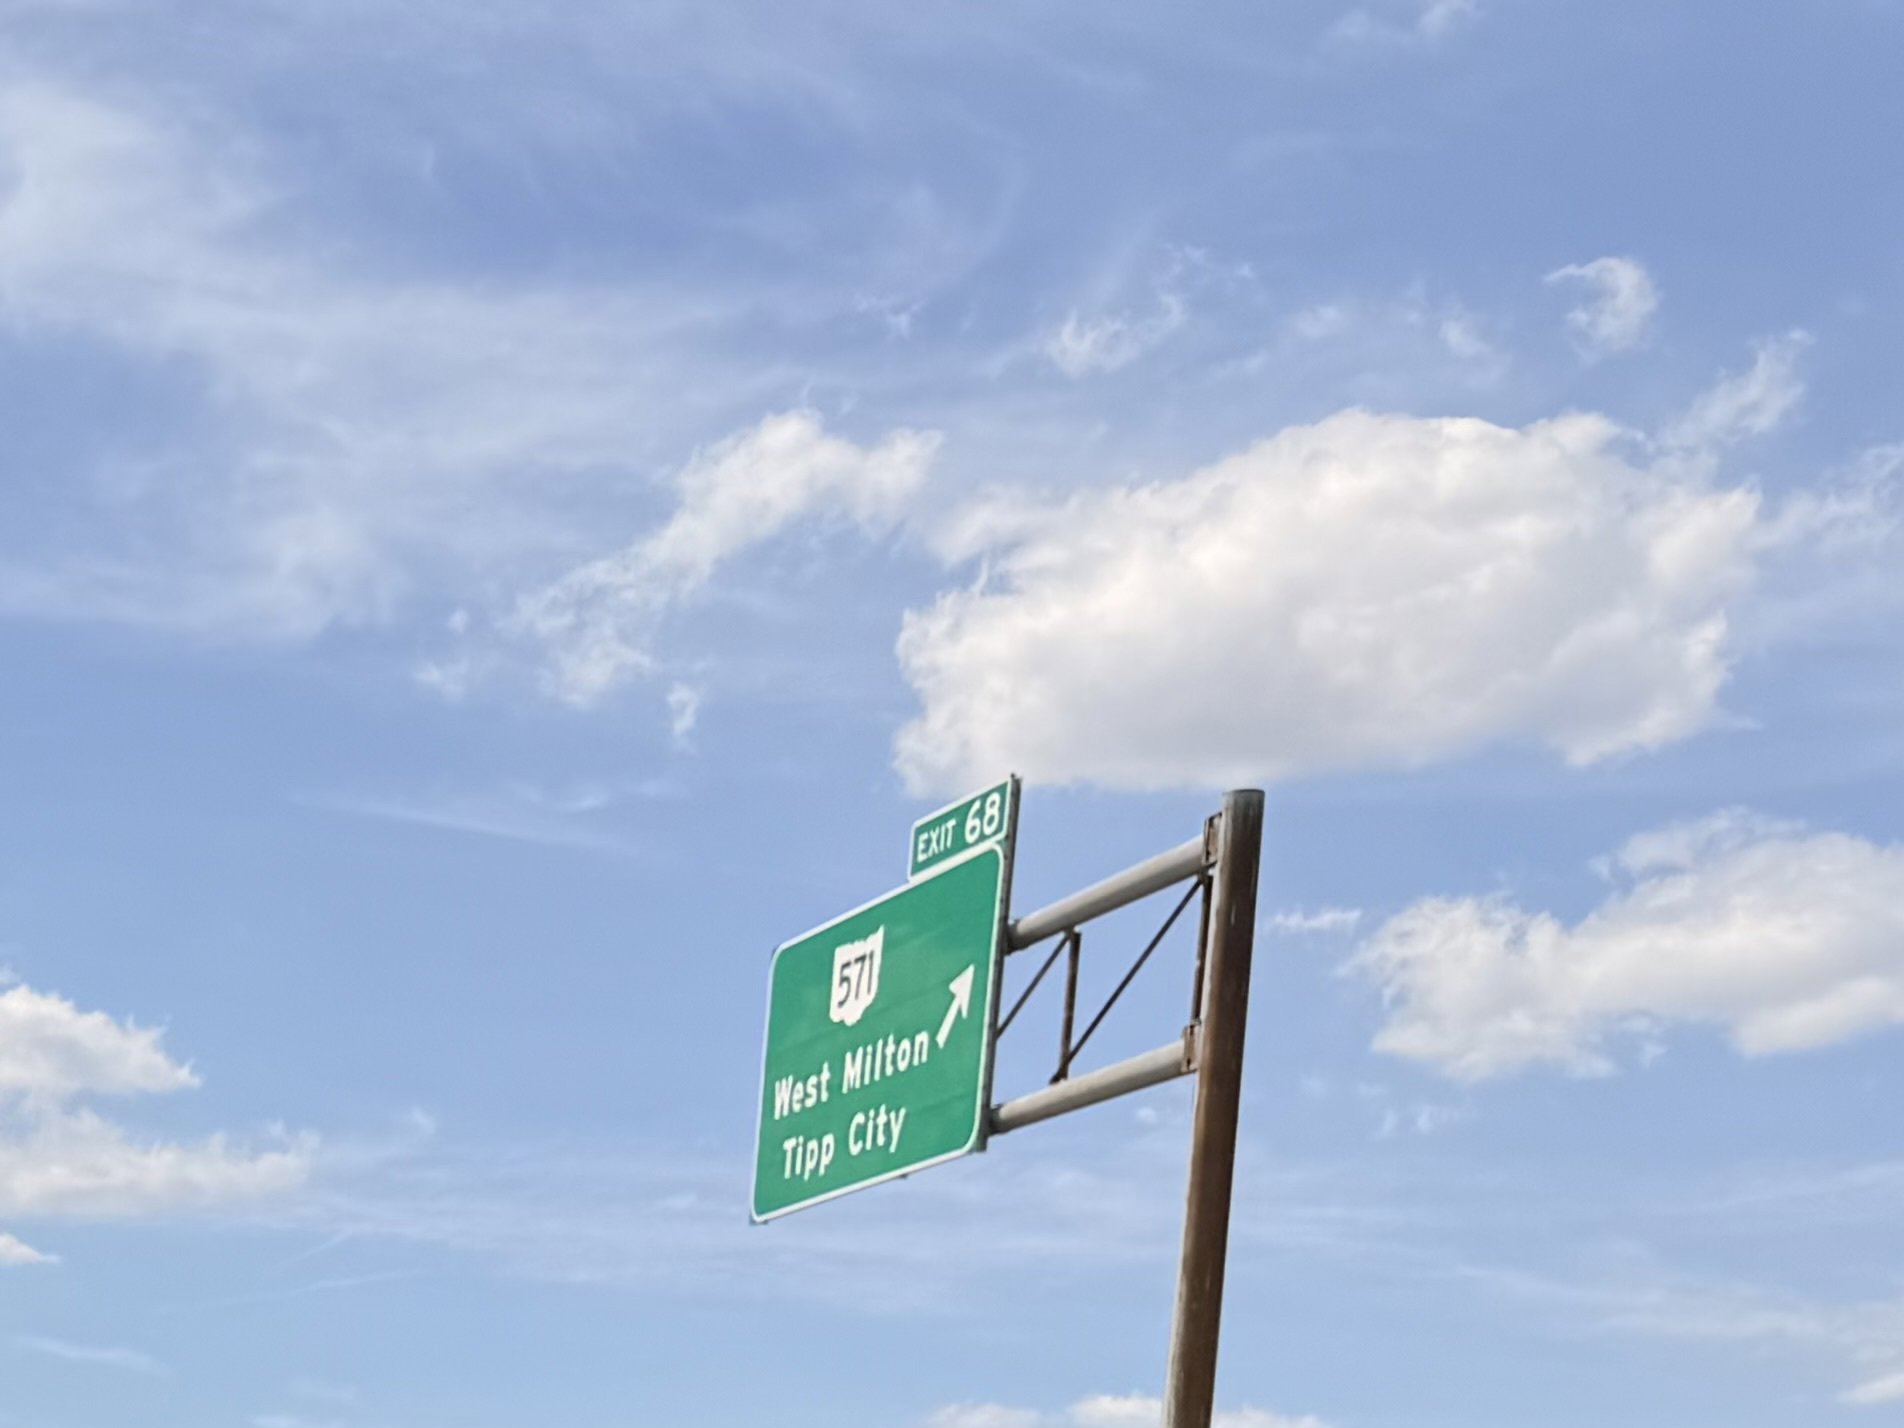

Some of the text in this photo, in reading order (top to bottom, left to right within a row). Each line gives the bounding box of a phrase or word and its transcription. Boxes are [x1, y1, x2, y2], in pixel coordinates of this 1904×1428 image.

[916, 791, 1001, 863] EXIT 68
[837, 952, 875, 1010] 571
[773, 1028, 929, 1121] West Milton
[783, 1106, 907, 1181] Tipp City
